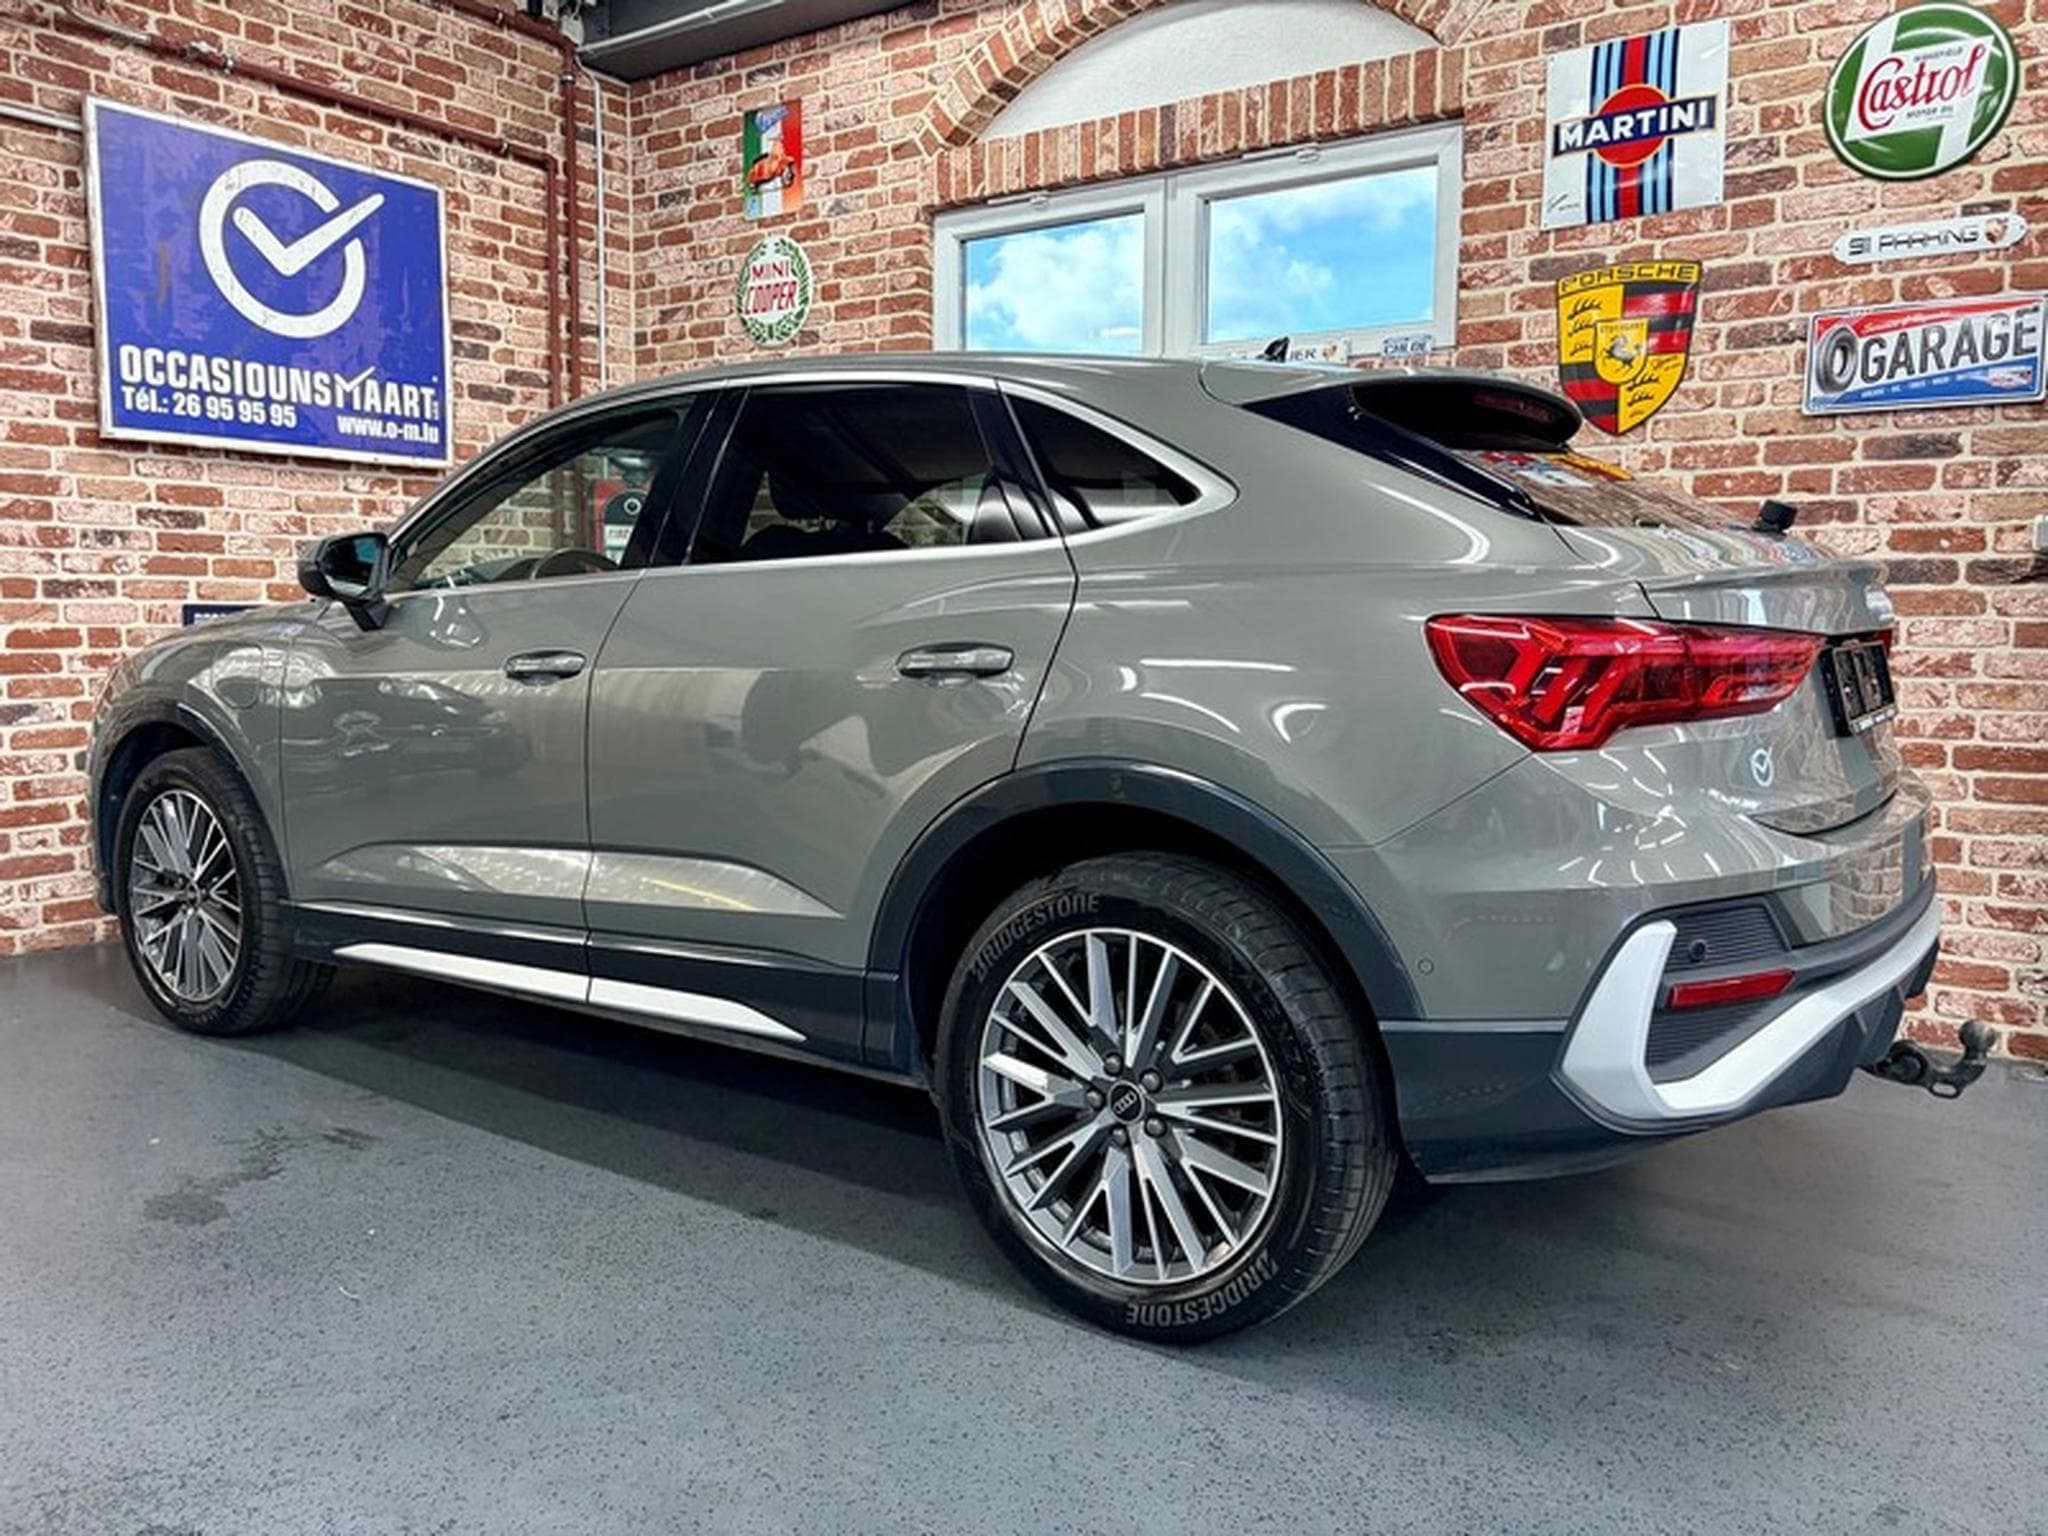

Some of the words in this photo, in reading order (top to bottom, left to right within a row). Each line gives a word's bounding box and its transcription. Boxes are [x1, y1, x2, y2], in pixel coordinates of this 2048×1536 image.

[1858, 43, 1987, 132] Castrol
[1558, 99, 1708, 151] MARTINI
[1878, 224, 1980, 252] PARKING
[751, 259, 790, 282] MINI
[1560, 264, 1696, 293] PORSCHE
[744, 280, 797, 315] COOPER
[1860, 304, 2040, 385] GARAGE
[118, 344, 436, 421] OCCASIOUNSMAART
[121, 385, 169, 414] Tél.:
[172, 393, 201, 418] 26
[206, 396, 234, 422] 95
[237, 400, 267, 425] 95
[270, 403, 298, 429] 95
[337, 414, 440, 444] www.o-m.lu
[969, 892, 1100, 983] BRIDGESTONE
[1125, 1248, 1281, 1328] BRIDGESTONE
